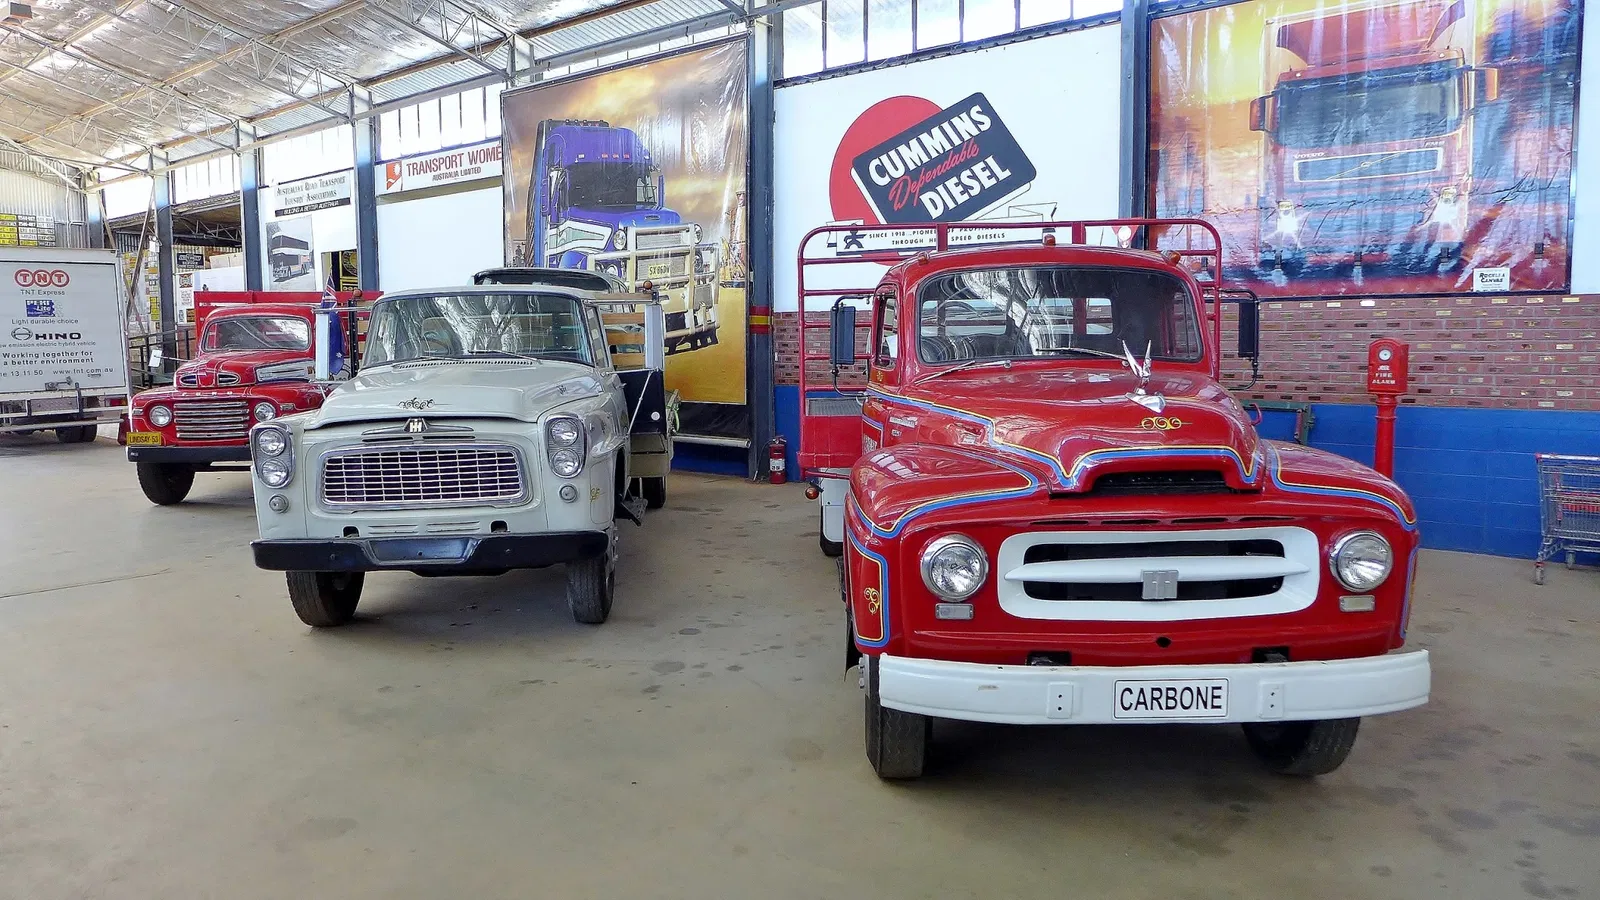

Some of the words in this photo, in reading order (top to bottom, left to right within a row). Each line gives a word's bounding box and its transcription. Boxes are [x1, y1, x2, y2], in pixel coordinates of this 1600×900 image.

[869, 105, 991, 186] CUMMINS
[406, 153, 464, 176] TRANSPORT
[432, 172, 459, 181] AUSTRALIA
[460, 166, 481, 176] LIMITED
[888, 138, 979, 211] Dependable
[919, 155, 1011, 219] DIESEL
[977, 232, 1005, 240] DIESELS
[18, 271, 67, 285] TNT
[35, 332, 81, 340] HINO
[2, 351, 40, 359] Working
[42, 350, 78, 358] together
[1120, 686, 1222, 711] CARBONE
